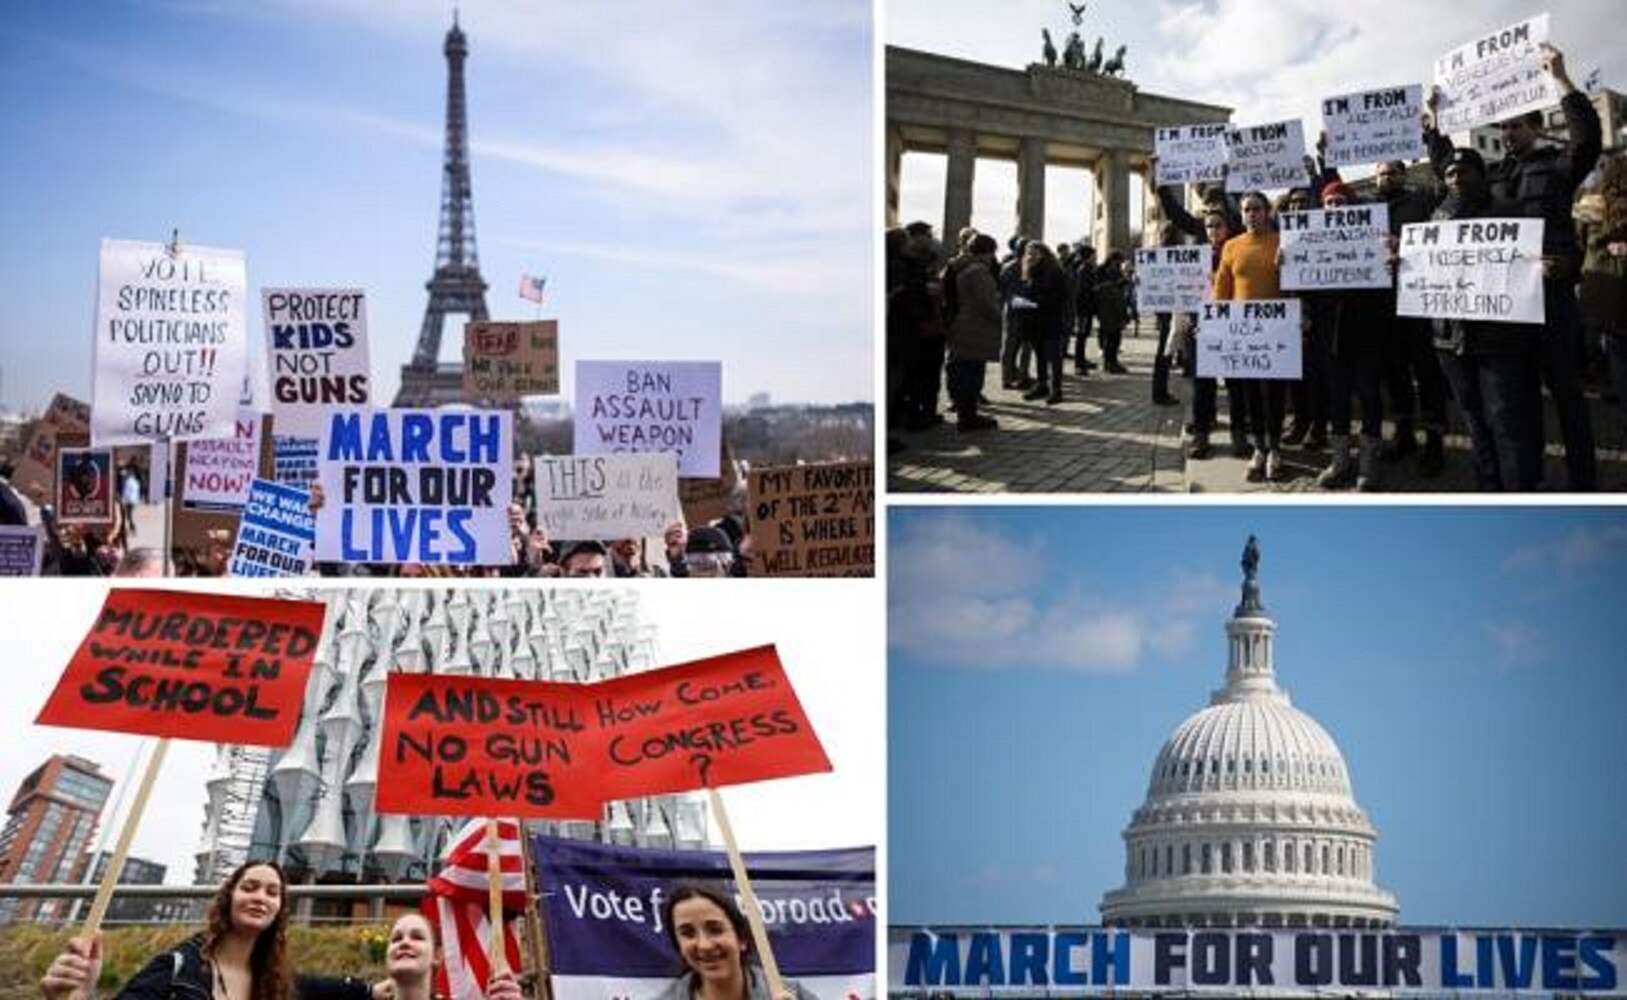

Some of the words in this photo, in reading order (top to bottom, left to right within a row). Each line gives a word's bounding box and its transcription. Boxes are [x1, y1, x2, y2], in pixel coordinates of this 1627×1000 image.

[1476, 22, 1530, 59] FROM
[1364, 87, 1406, 110] FROM
[1251, 122, 1288, 142] FROM
[1324, 208, 1372, 228] FROM
[1404, 225, 1440, 245] I'M
[1457, 222, 1521, 244] FROM
[1166, 249, 1200, 263] FROM
[117, 284, 232, 315] SPINELESS
[268, 294, 365, 320] PROTECT
[1244, 302, 1286, 319] FROM
[109, 318, 230, 345] POLITICIANS
[272, 322, 355, 349] KIDS
[276, 352, 336, 376] NOT
[275, 374, 369, 404] GUNS
[626, 371, 671, 394] BAN
[592, 395, 705, 421] ASSAULT
[133, 411, 207, 437] GUNS
[328, 413, 500, 463] MARCH
[597, 424, 693, 446] WEAPON
[343, 465, 413, 505] FOR
[419, 466, 496, 508] OUR
[542, 457, 606, 496] THIS
[759, 470, 793, 495] MY
[756, 499, 780, 521] OF
[787, 494, 818, 518] THE
[241, 525, 300, 555] MARCH
[341, 507, 477, 563] LIVES
[802, 517, 857, 541] WHERE
[236, 542, 270, 564] FOR
[95, 606, 320, 658] MURDERED
[90, 641, 204, 669] WHILE
[221, 652, 281, 679] IN
[80, 666, 280, 720] SCHOOL
[408, 687, 501, 726] AND
[505, 695, 586, 732] STILL
[396, 731, 468, 763] NO
[485, 731, 570, 764] GUN
[608, 710, 799, 766] CONGRESS
[690, 754, 713, 785] ?
[432, 767, 555, 805] LAWS
[564, 884, 645, 922] Vote
[904, 930, 1131, 986] MARCH
[1154, 932, 1275, 986] FOR
[1294, 932, 1423, 986] OUR
[1438, 932, 1616, 991] LIVES
